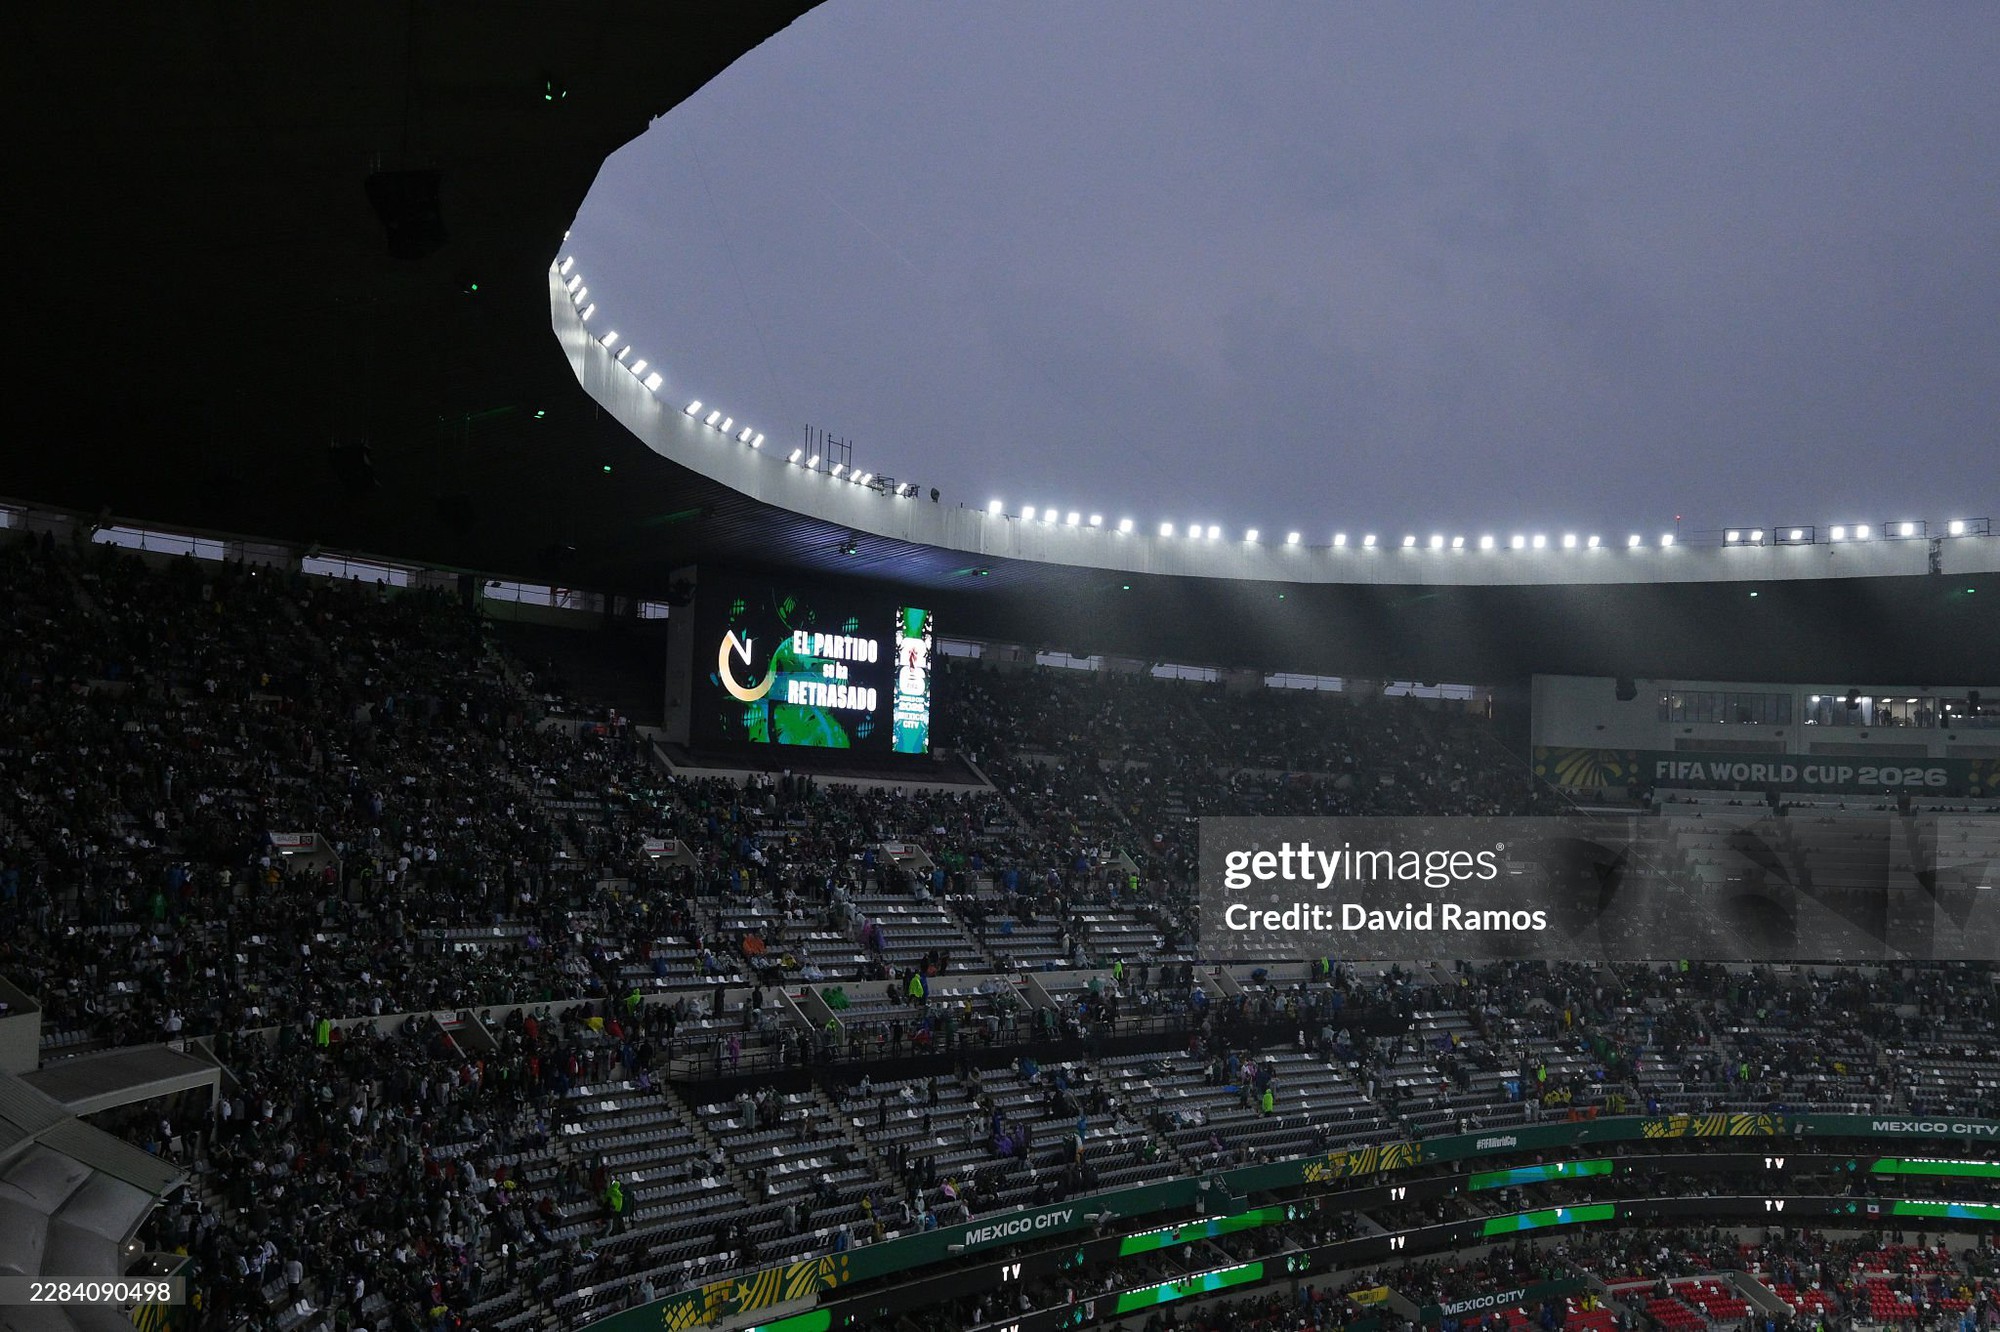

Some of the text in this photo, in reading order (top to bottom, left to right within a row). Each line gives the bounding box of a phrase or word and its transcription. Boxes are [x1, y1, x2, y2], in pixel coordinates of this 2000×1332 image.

[794, 630, 878, 663] EL PARTIDO
[788, 680, 877, 711] RETRASADO
[903, 720, 920, 729] CITY
[1655, 760, 1948, 787] FIFA WORLD CUP 2026
[1872, 1121, 1999, 1136] MEXICO CITY
[1764, 1157, 1785, 1169] TV
[1390, 1186, 1406, 1201] TV
[1764, 1200, 1785, 1212] TV
[965, 1209, 1073, 1246] MEXICO CITY
[1390, 1236, 1405, 1250] TV
[1002, 1263, 1022, 1282] TV
[1444, 1288, 1526, 1316] MEXICO CITY
